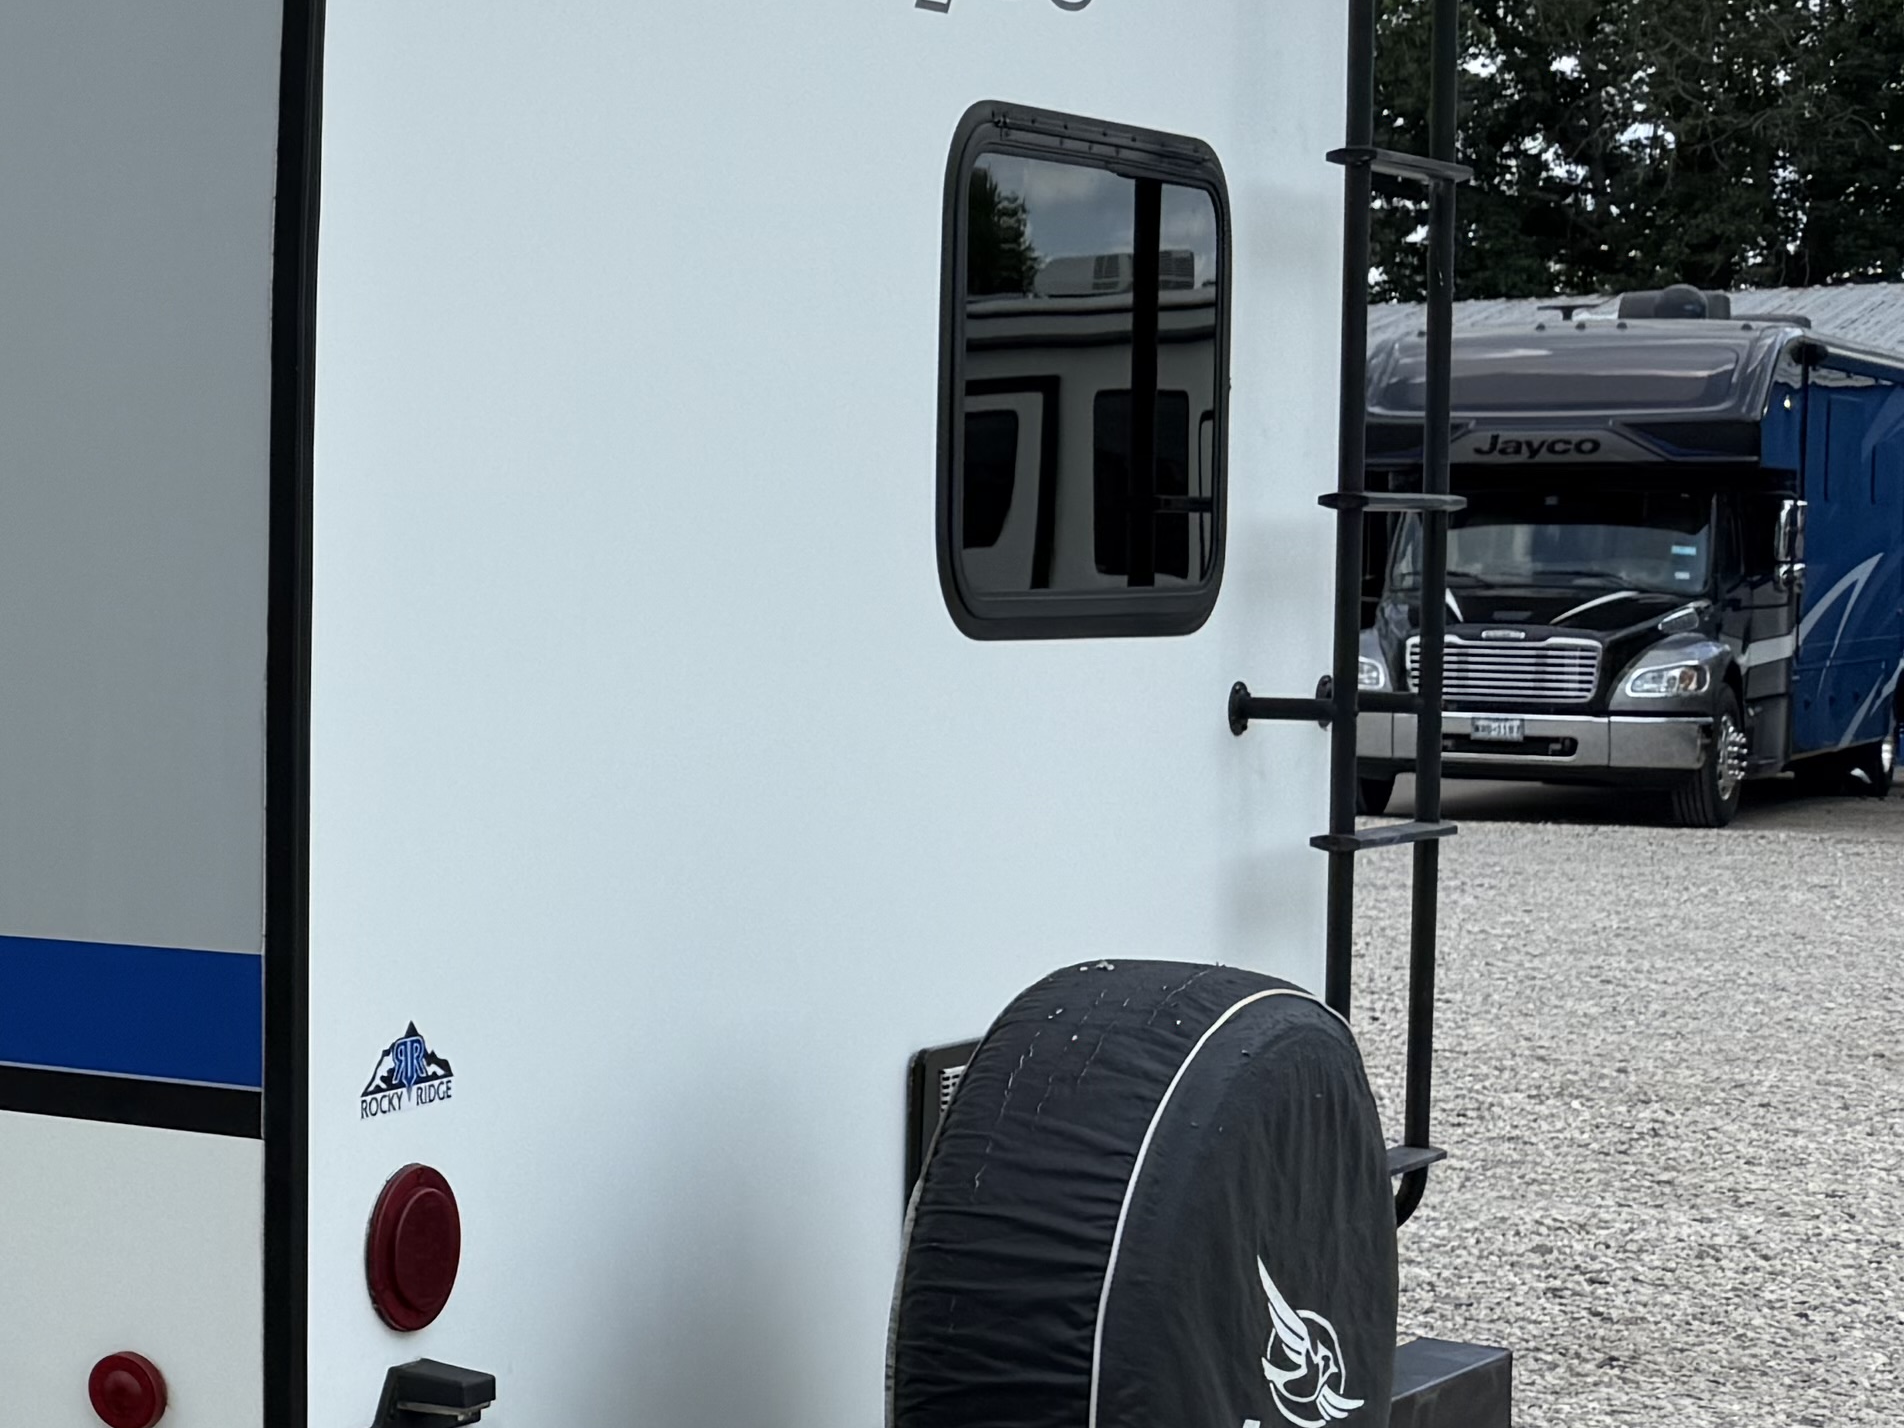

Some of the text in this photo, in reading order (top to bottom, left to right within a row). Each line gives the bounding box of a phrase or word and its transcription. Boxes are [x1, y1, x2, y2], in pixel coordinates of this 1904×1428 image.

[1473, 433, 1601, 459] Jayco
[361, 1080, 452, 1119] ROCKY RIDGE
